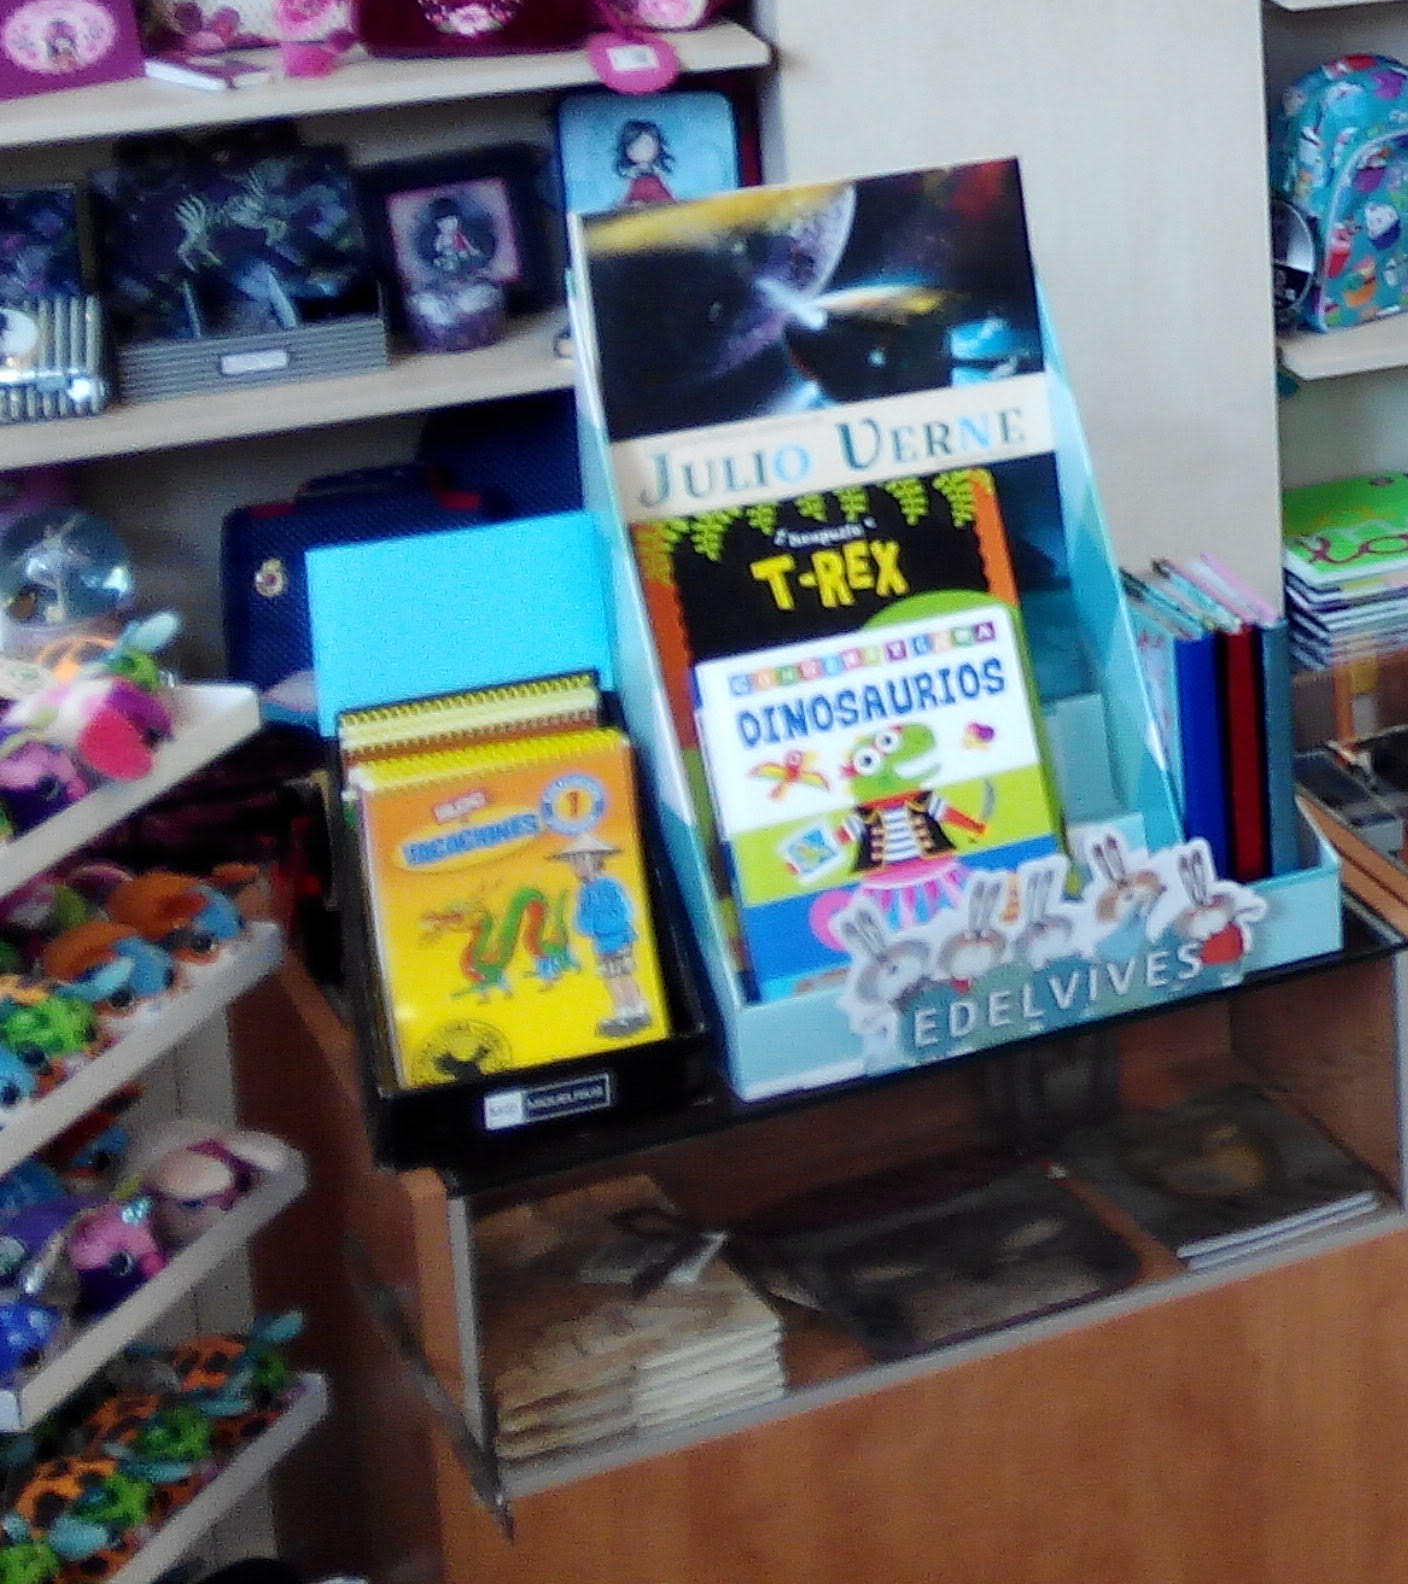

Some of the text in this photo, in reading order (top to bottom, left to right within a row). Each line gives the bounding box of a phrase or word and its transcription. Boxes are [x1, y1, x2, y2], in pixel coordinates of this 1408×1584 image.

[638, 407, 1027, 510] JULIO VERNE
[750, 538, 911, 611] T-REX
[736, 657, 1006, 749] DINOSAURIOS
[911, 941, 1204, 1048] EDELVIVES
